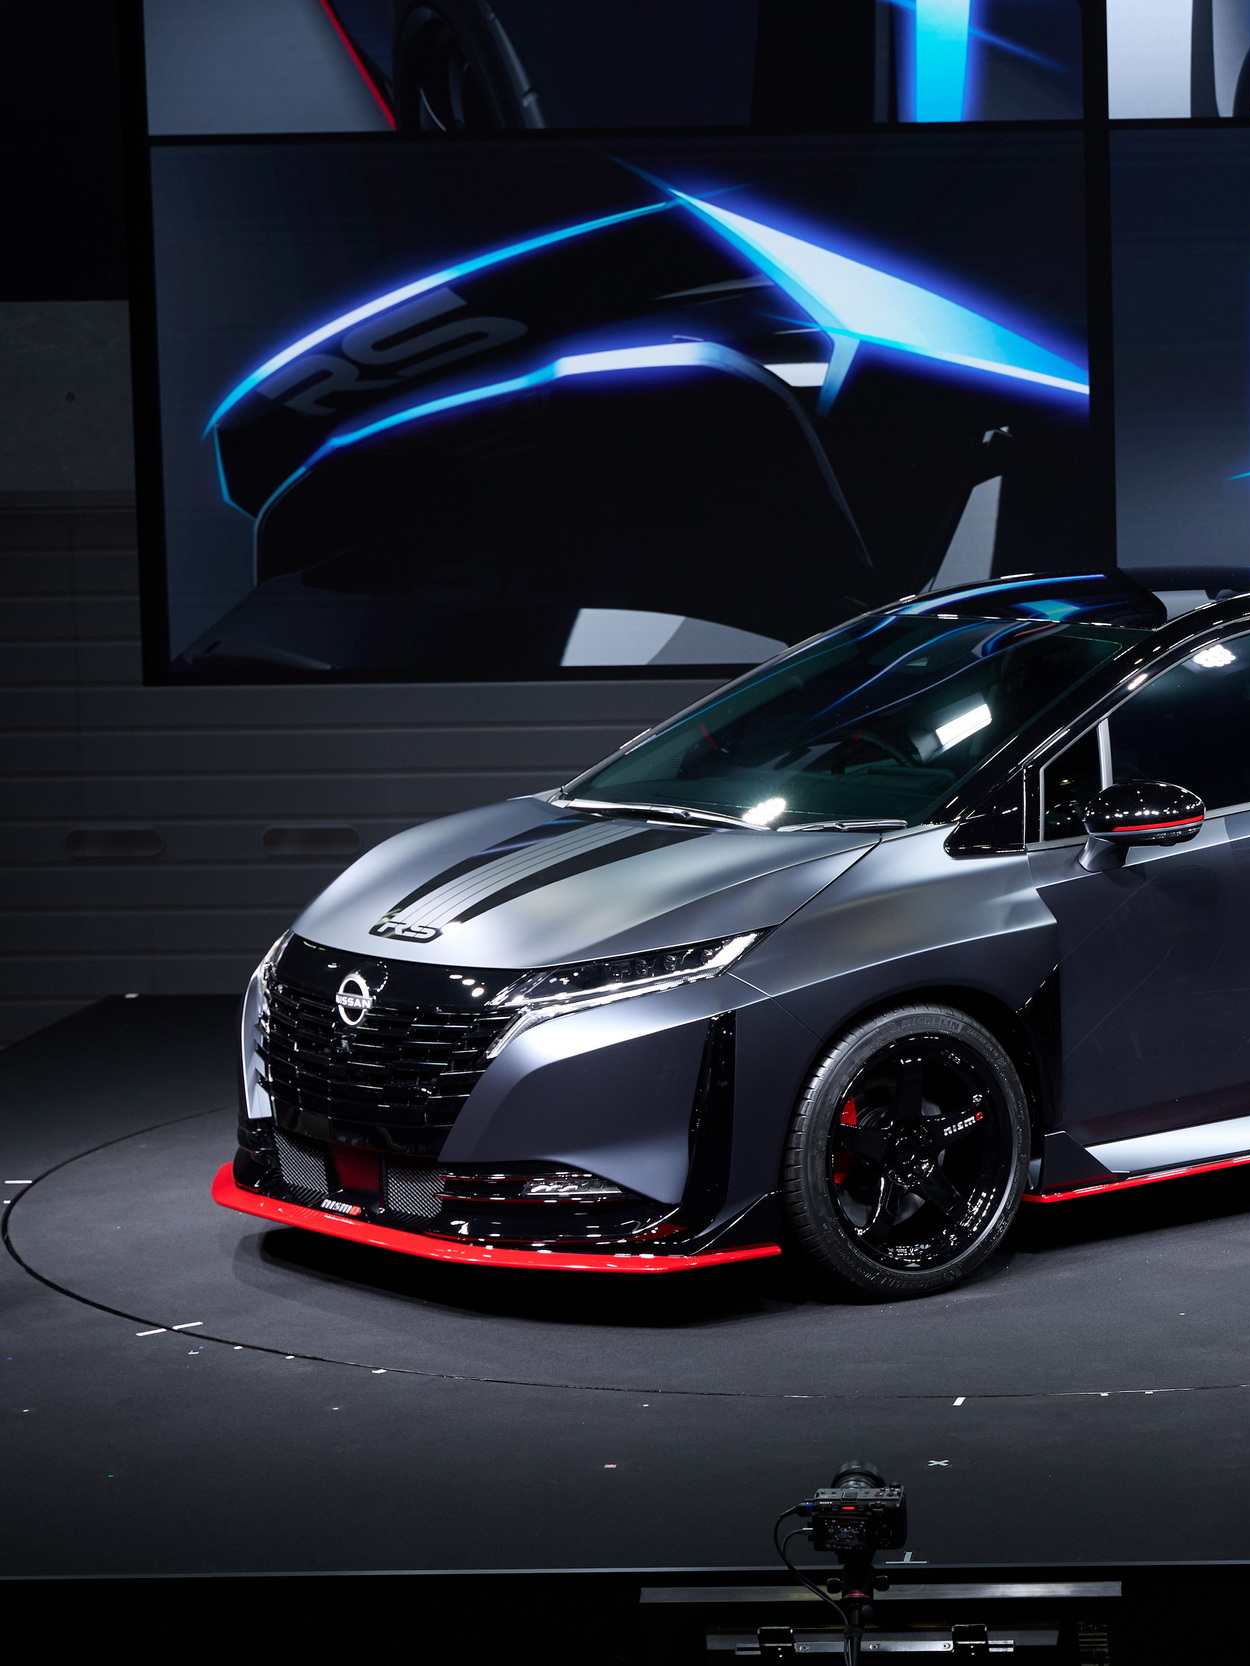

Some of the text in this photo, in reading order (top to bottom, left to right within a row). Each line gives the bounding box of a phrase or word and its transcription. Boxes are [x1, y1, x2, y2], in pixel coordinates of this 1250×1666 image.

[256, 286, 528, 416] RS
[376, 916, 437, 939] RS
[335, 994, 371, 1009] NISSAN
[901, 1016, 960, 1032] MICHELIN
